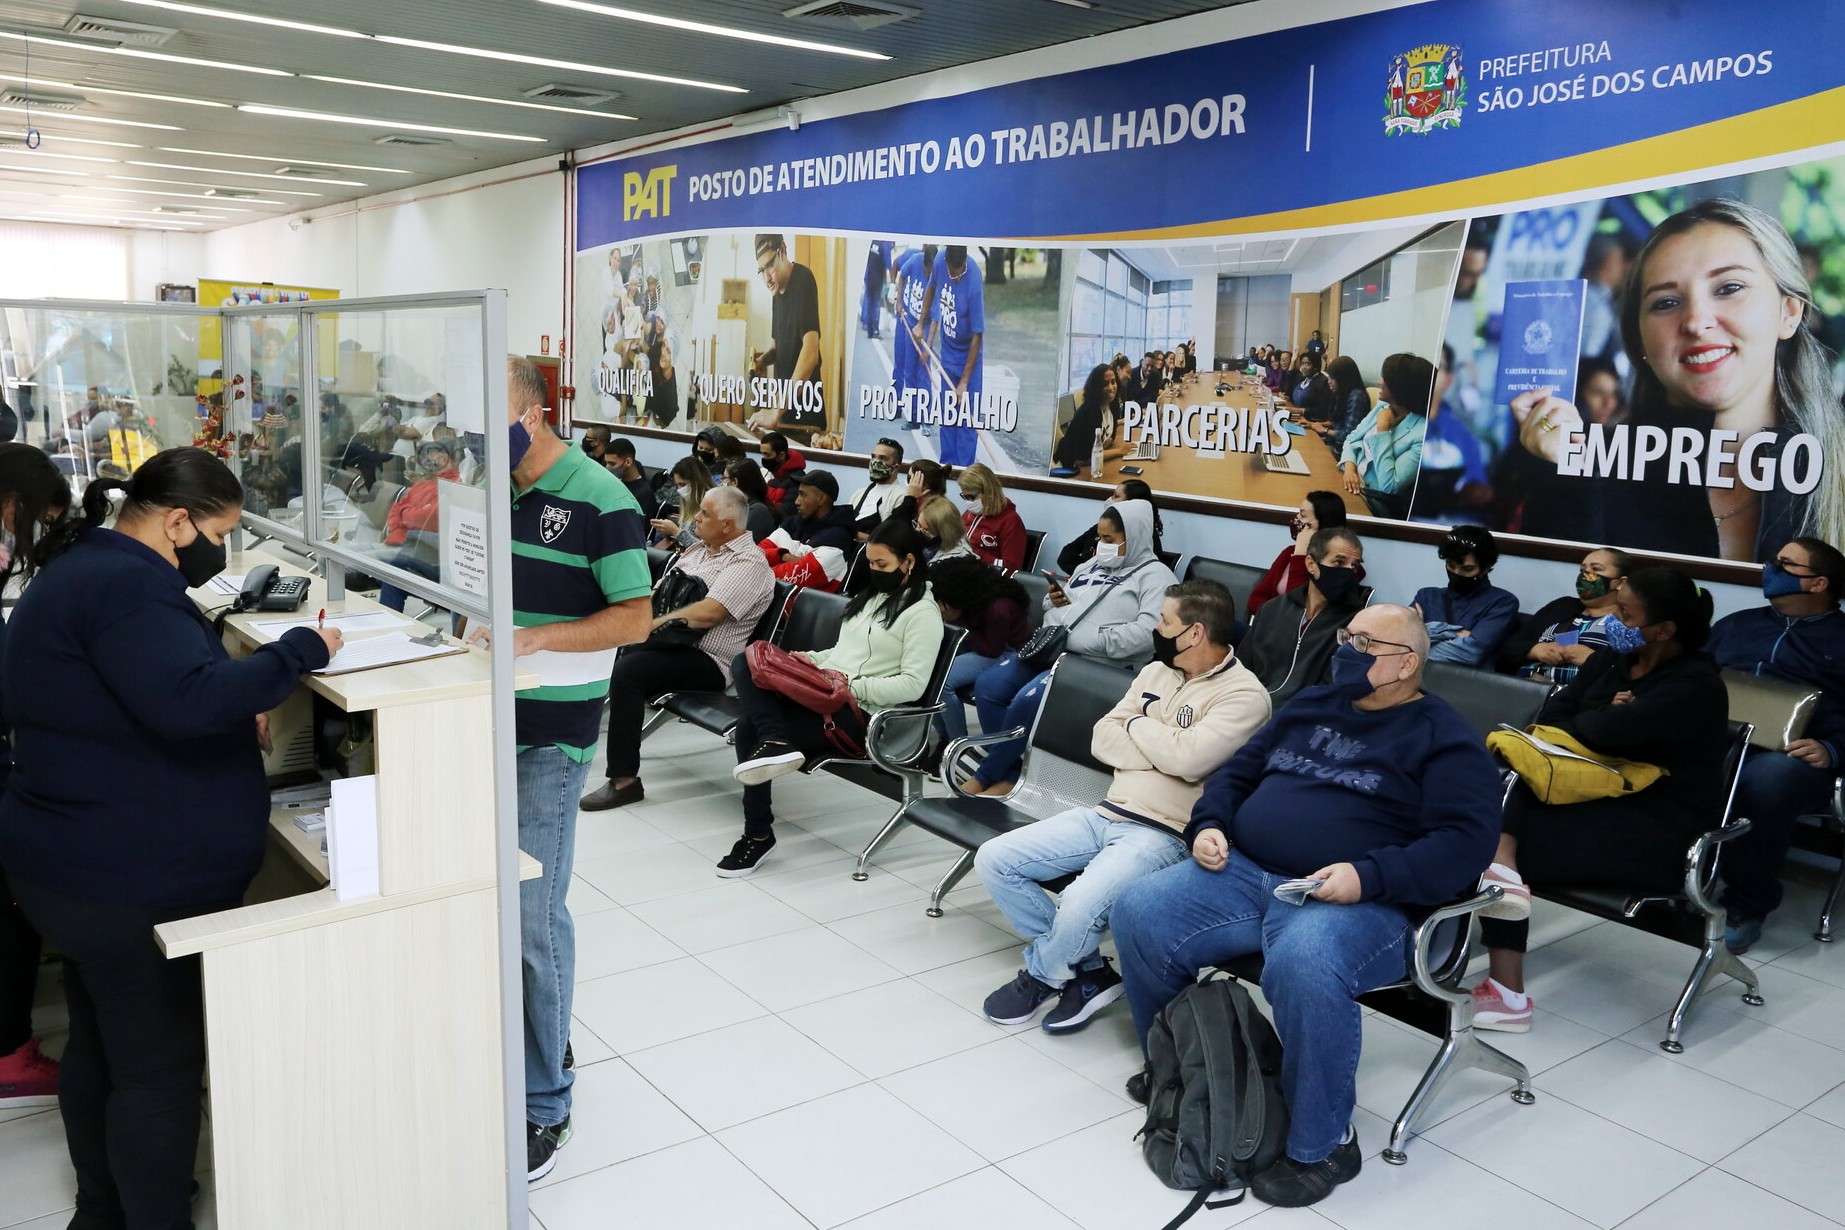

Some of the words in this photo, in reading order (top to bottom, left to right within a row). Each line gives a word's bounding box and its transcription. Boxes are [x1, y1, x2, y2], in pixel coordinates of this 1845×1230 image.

[1477, 86, 1523, 113] SÃO
[1527, 74, 1586, 107] JOSÉ
[1591, 69, 1645, 97] DOS
[1651, 50, 1773, 88] CAMPOS
[1479, 40, 1612, 80] PREFEITURA
[689, 168, 746, 202] POSTO
[749, 164, 773, 195] DE
[776, 140, 940, 192] ATENDIMENTO
[944, 133, 986, 171] AO
[991, 93, 1246, 165] TRABALHADOR
[623, 164, 677, 221] PAT
[598, 368, 654, 398] QUALIFICA
[700, 374, 746, 405] QUERO
[750, 377, 823, 420] SERVIÇOS
[859, 379, 1018, 433] PRÓ-TRABALHO
[1123, 401, 1292, 456] PARCERIAS
[1557, 421, 1823, 494] EMPREGO
